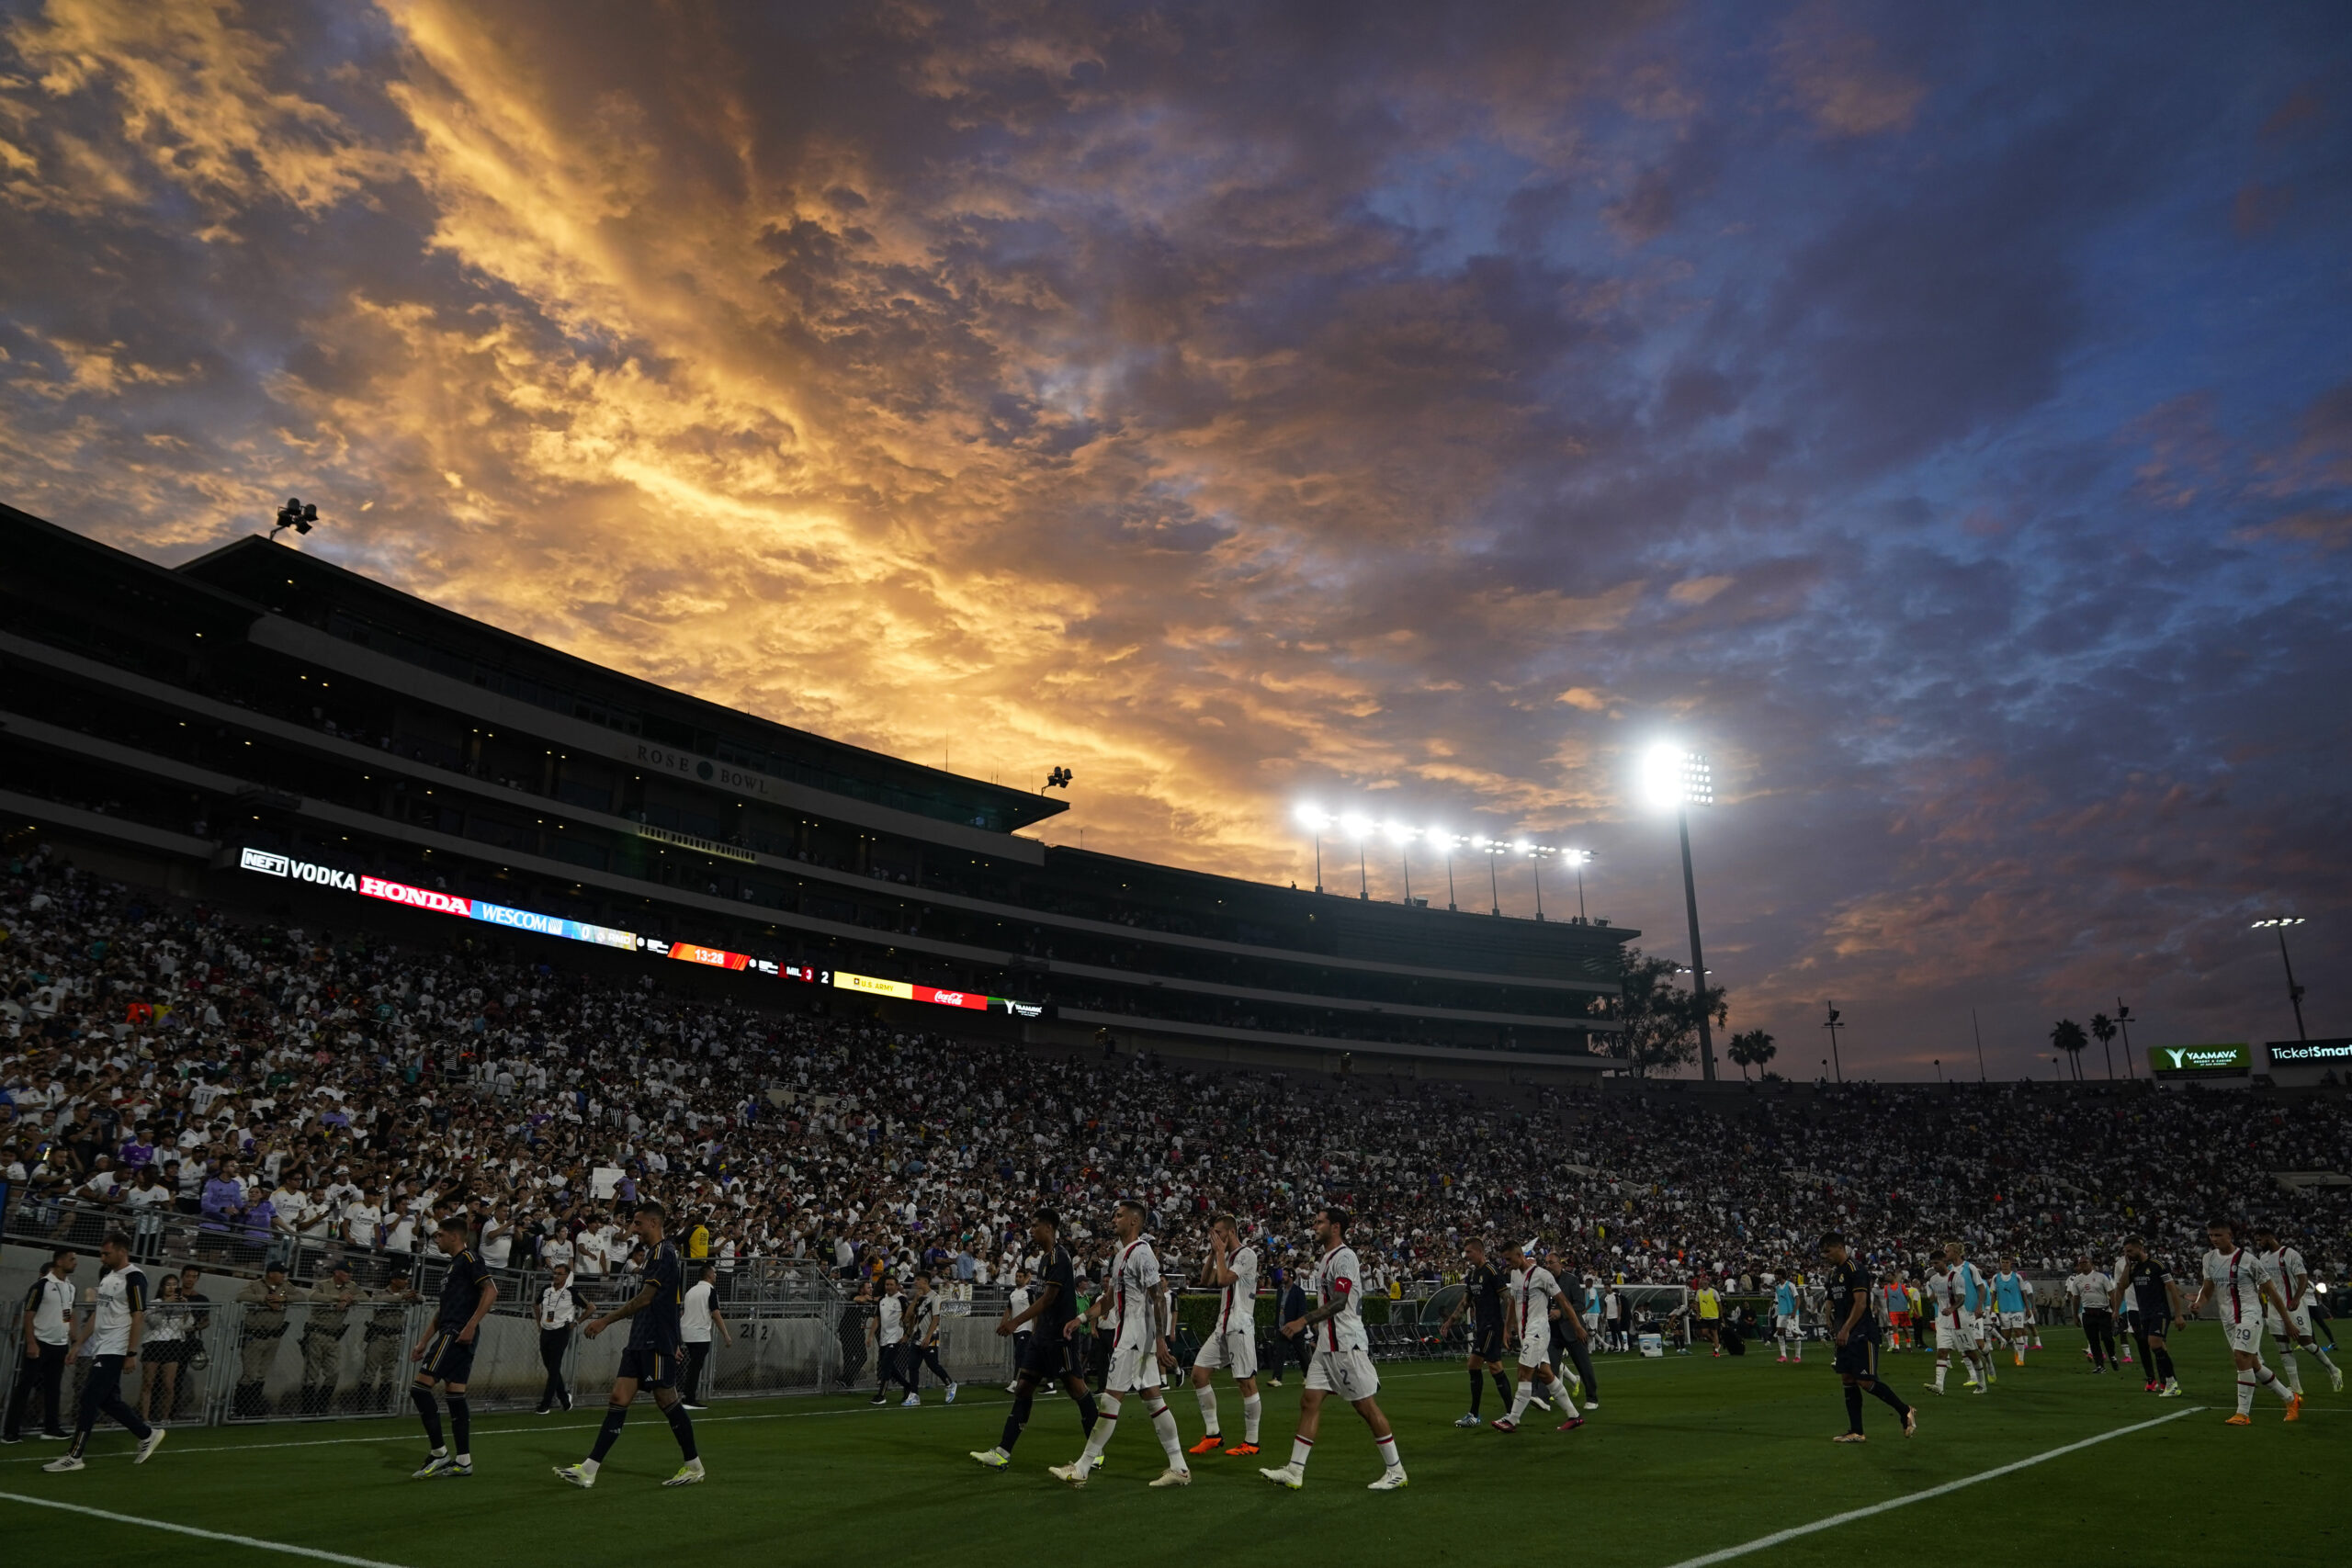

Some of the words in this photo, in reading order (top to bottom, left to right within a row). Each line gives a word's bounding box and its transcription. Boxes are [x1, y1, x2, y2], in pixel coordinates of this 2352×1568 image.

[637, 745, 689, 772] ROSE
[720, 769, 768, 794] BOWL
[639, 826, 667, 840] TERRY
[245, 852, 285, 872] NEFT
[290, 860, 357, 892] VODKA
[360, 876, 470, 916] HONDA
[482, 904, 547, 932] WESCOM
[608, 934, 631, 945] RMD
[695, 949, 724, 964] 13:28
[786, 966, 802, 977] MIL
[820, 971, 830, 984] 2
[875, 983, 894, 992] ARMY
[2296, 1315, 2304, 1325] 8
[2236, 1328, 2251, 1340] 29
[1340, 1369, 1351, 1384] 2
